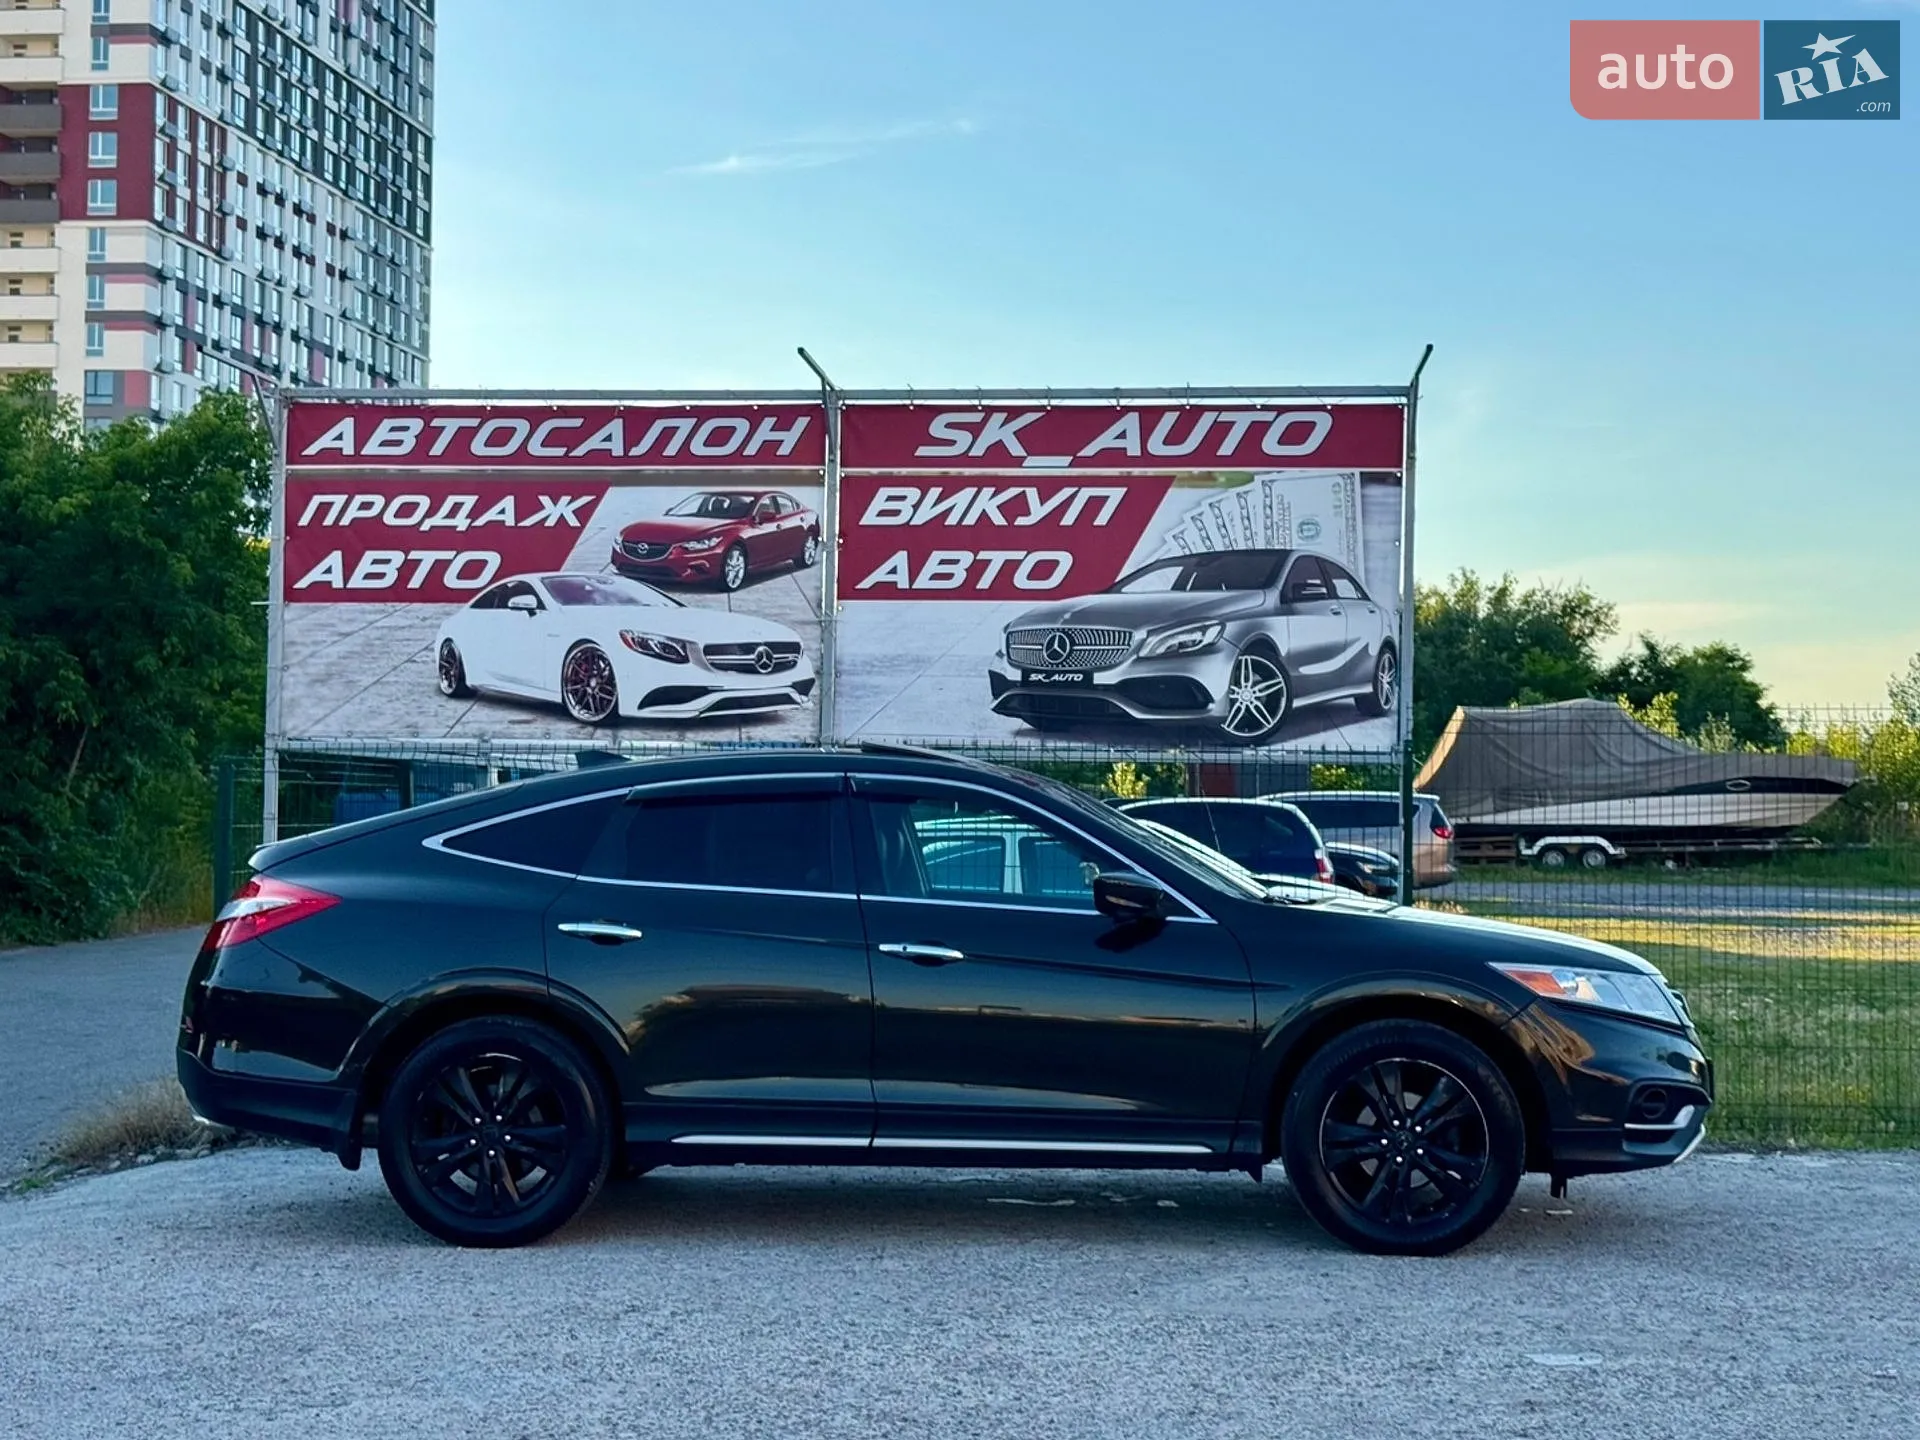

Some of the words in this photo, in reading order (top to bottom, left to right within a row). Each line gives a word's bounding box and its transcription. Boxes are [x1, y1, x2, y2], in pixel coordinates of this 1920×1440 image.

[301, 416, 812, 457] АВТОСАЛОН
[914, 410, 1334, 468] SK_AUTO
[297, 493, 597, 532] ПРОДАЖ
[858, 486, 1129, 527] ВИКУП
[292, 550, 503, 590] АВТО
[855, 550, 1075, 590] АВТО
